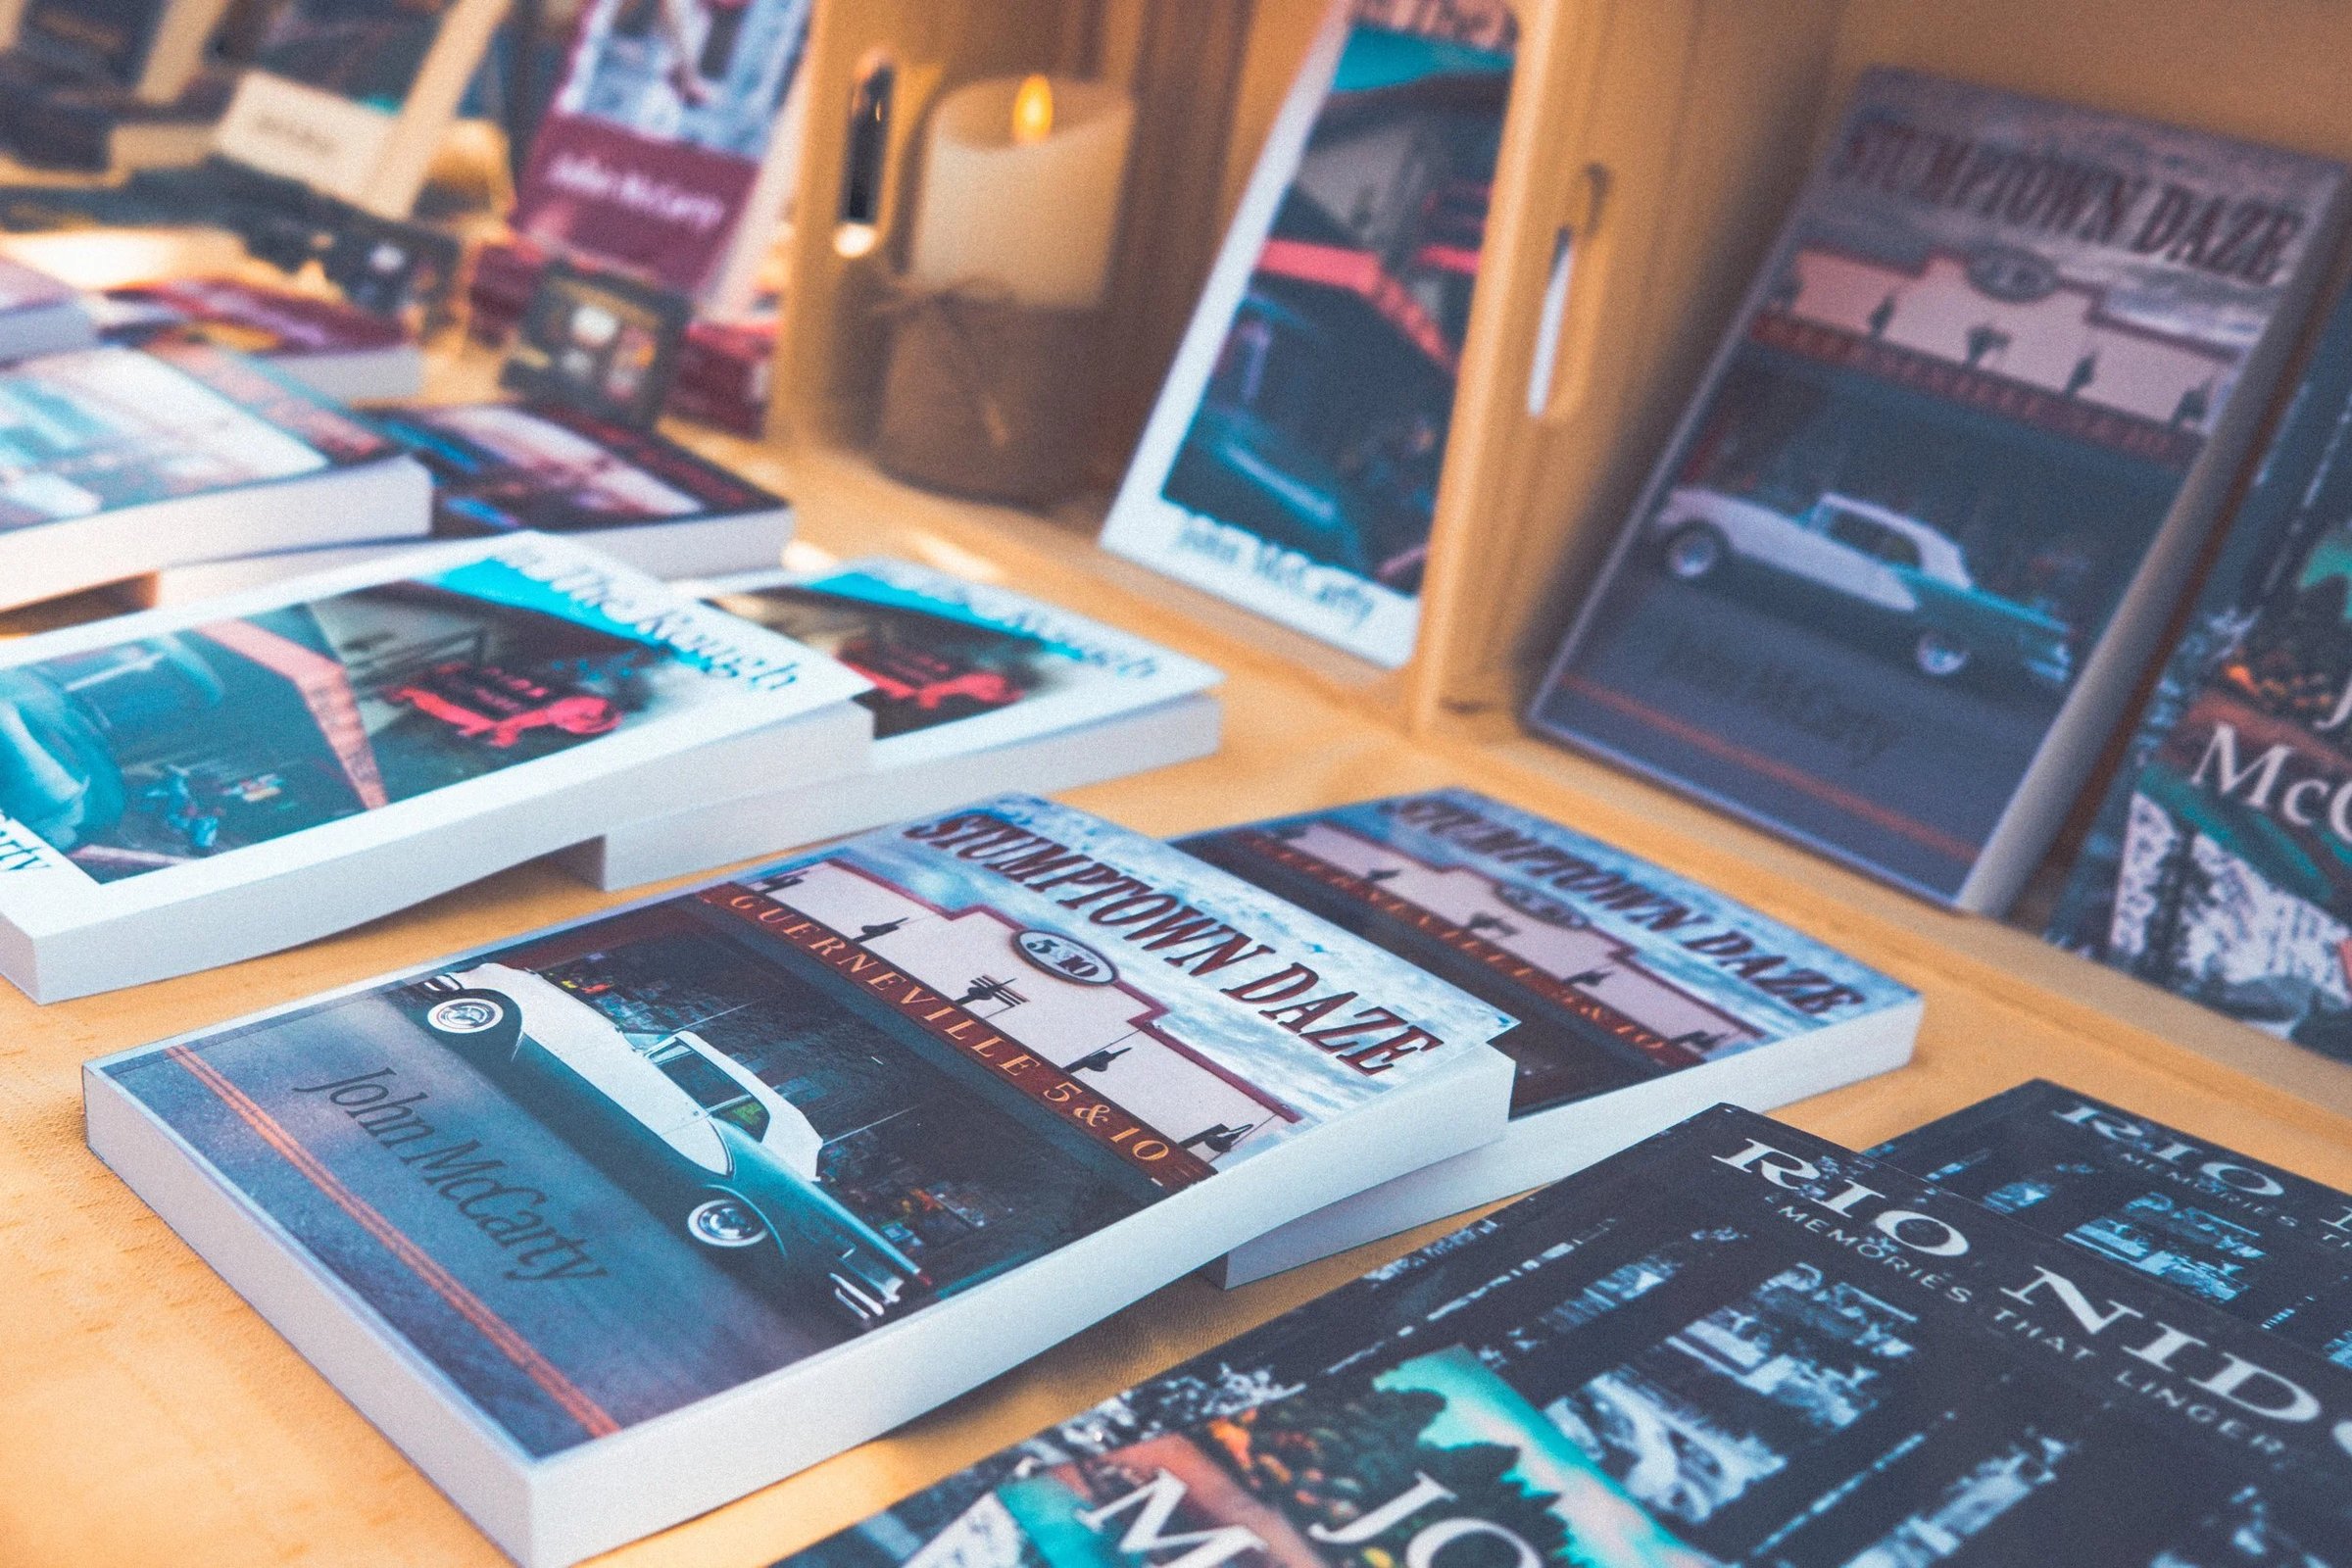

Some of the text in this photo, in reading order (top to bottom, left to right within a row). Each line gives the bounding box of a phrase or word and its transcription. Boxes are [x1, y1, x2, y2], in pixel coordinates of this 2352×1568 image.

[2129, 182, 2305, 287] DAZE
[728, 893, 1041, 1076] GUERNEVILLE
[903, 812, 1446, 1079] STUMPTOWN DAZE
[1679, 931, 1868, 1016] DAZE
[295, 1066, 607, 1286] John McCarty
[1711, 1137, 1970, 1257] RIO
[2051, 1104, 2285, 1197] RIO
[1777, 1204, 2286, 1455] MEMORIES THAT LINGER
